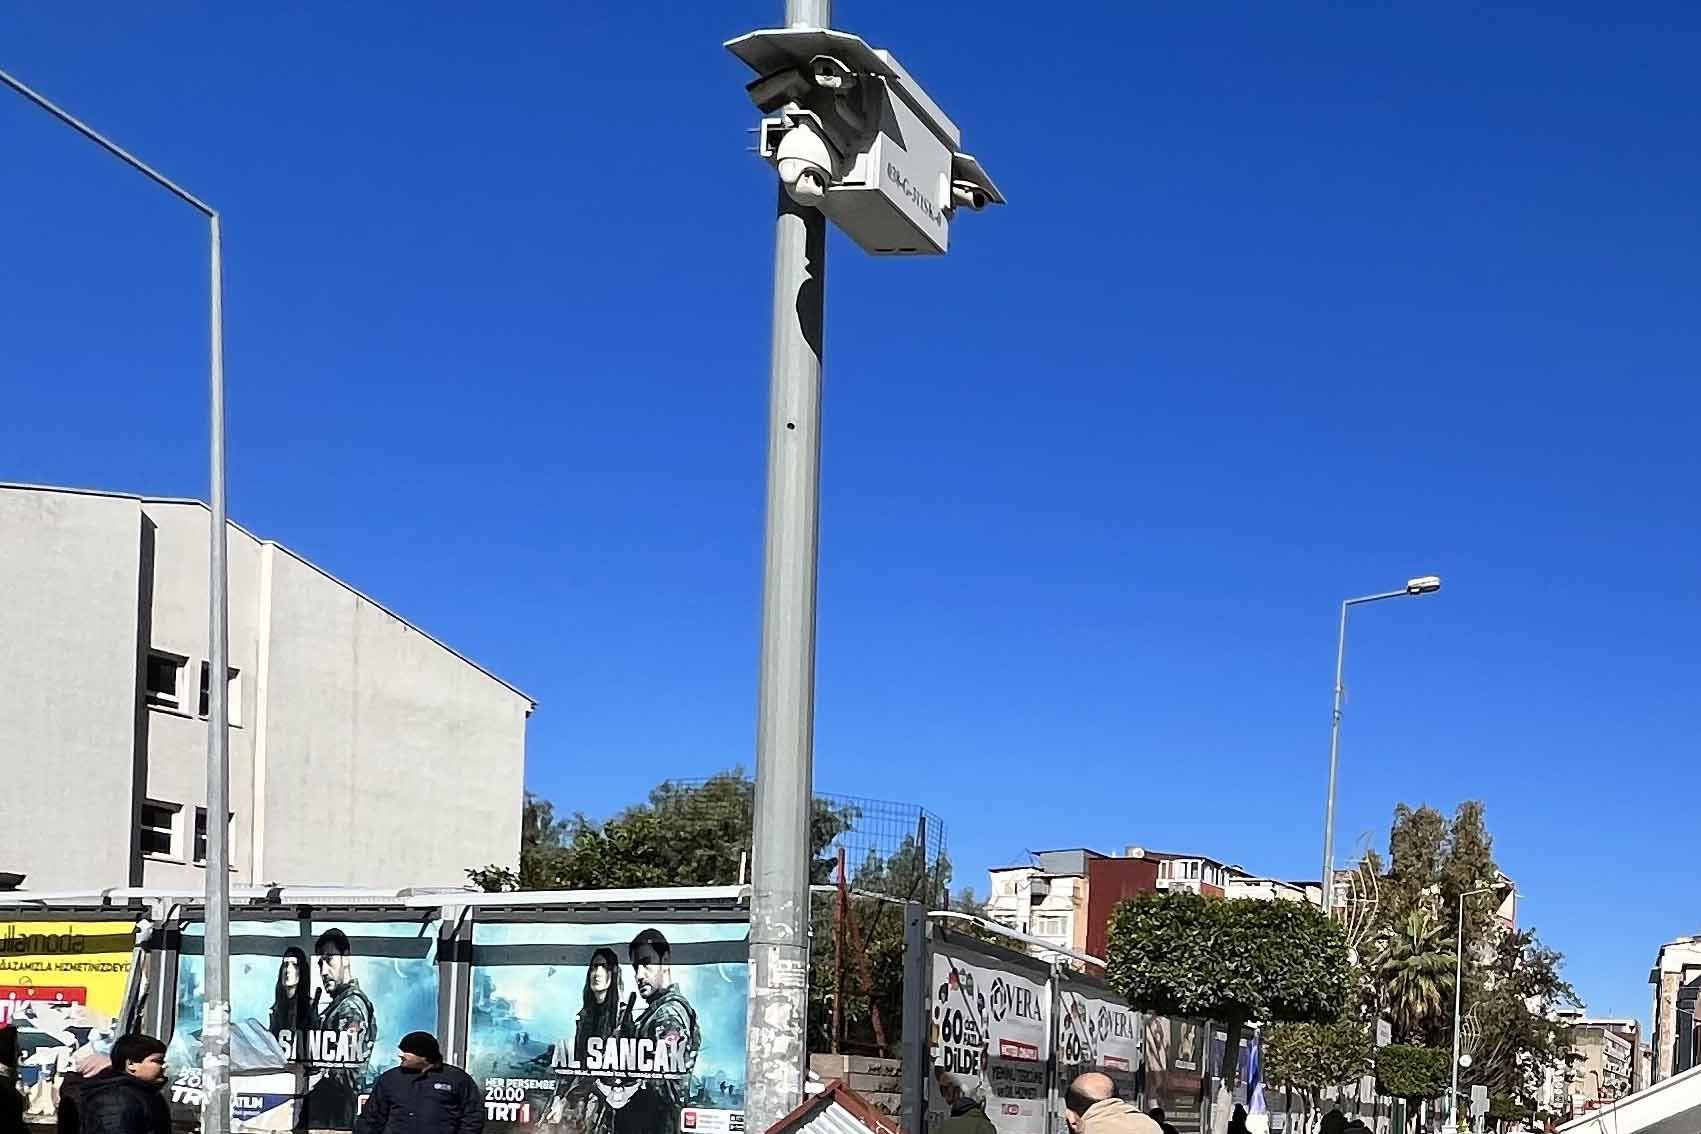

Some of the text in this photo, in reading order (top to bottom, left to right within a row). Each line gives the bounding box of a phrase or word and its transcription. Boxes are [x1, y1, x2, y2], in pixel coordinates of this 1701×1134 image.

[1006, 983, 1042, 1021] VERA
[942, 1008, 963, 1045] 60
[1109, 1010, 1134, 1038] VERA
[552, 1037, 687, 1073] AL SANCAK
[485, 1078, 505, 1087] HER
[485, 1087, 525, 1101] 20.00
